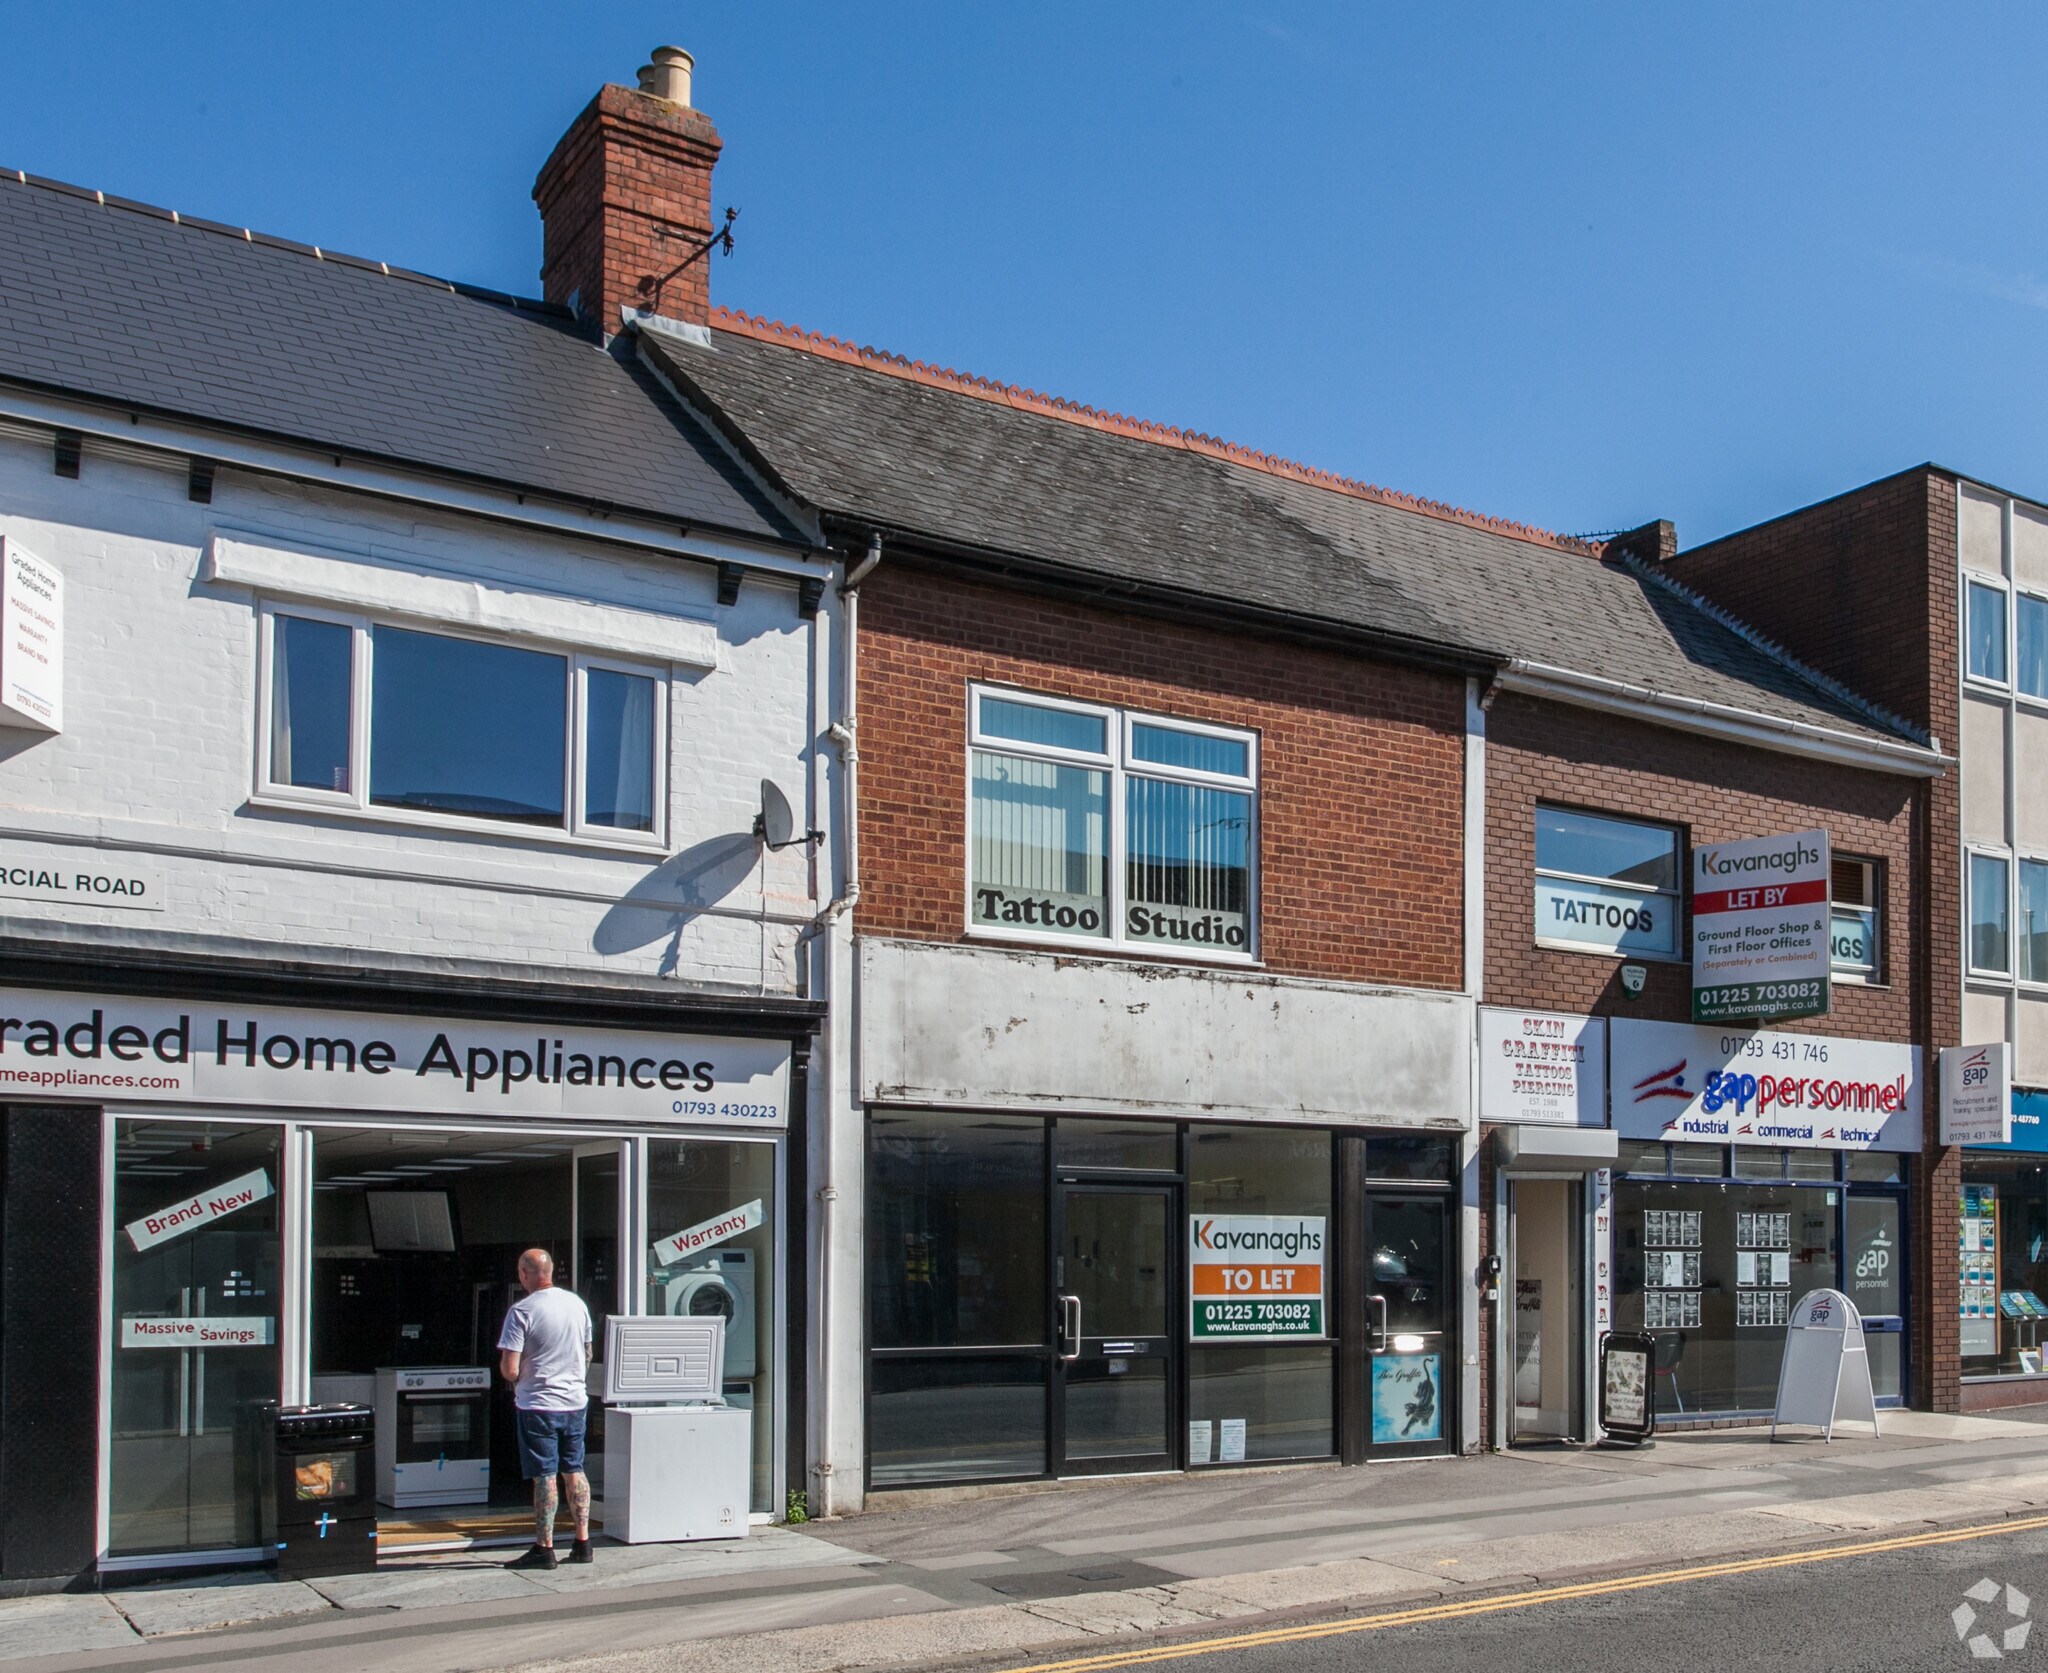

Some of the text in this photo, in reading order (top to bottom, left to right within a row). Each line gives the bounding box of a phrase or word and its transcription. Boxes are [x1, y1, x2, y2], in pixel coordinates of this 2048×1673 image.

[12, 553, 56, 590] Graded Home
[17, 571, 52, 601] Appliances
[11, 597, 55, 630] MASSIVE SAVINGS
[19, 622, 47, 645] WARRANTY
[17, 641, 48, 665] BRAND NEW
[1702, 841, 1819, 875] Kavanaghs
[76, 874, 145, 896] ROAD
[1728, 887, 1788, 908] LET BY
[977, 888, 1244, 946] Tattoo Studio
[1551, 897, 1653, 932] TATTOOS
[1698, 920, 1822, 942] Ground Floor Shop &
[1708, 937, 1811, 955] First Floor Offices
[1703, 951, 1817, 970] (Separately or Combined)
[1700, 982, 1819, 1005] 01225 703082
[1701, 998, 1818, 1016] www.kavanaghs.co.uk
[1523, 1018, 1565, 1038] SKIN
[0, 1009, 715, 1094] raded Home Appliances
[1502, 1039, 1585, 1063] GRAFFITI
[1721, 1036, 1828, 1063] 01793 431 746
[0, 1068, 180, 1089] meappliances.com
[1515, 1063, 1572, 1079] TATTOOS
[1962, 1067, 1988, 1085] gap
[1512, 1080, 1575, 1097] PIERCING
[672, 1101, 777, 1118] 01793 430223
[1529, 1097, 1558, 1106] EST. 1988
[1522, 1109, 1541, 1118] 01793
[1683, 1118, 1729, 1135] industrial
[1757, 1125, 1813, 1139] commercial
[1840, 1127, 1880, 1142] technical
[1949, 1130, 2002, 1141] 01793 431 746
[145, 1189, 253, 1235] Brand New
[672, 1214, 746, 1252] Warranty
[1194, 1220, 1321, 1258] Kavanaghs
[1856, 1250, 1889, 1277] gap
[1222, 1269, 1295, 1290] TO LET
[1856, 1278, 1889, 1291] personnel
[1206, 1304, 1310, 1320] 01225 703082
[1810, 1310, 1829, 1322] gap
[134, 1322, 255, 1342] Massive Savings
[1207, 1320, 1309, 1332] www.kavanaghs.co.uk
